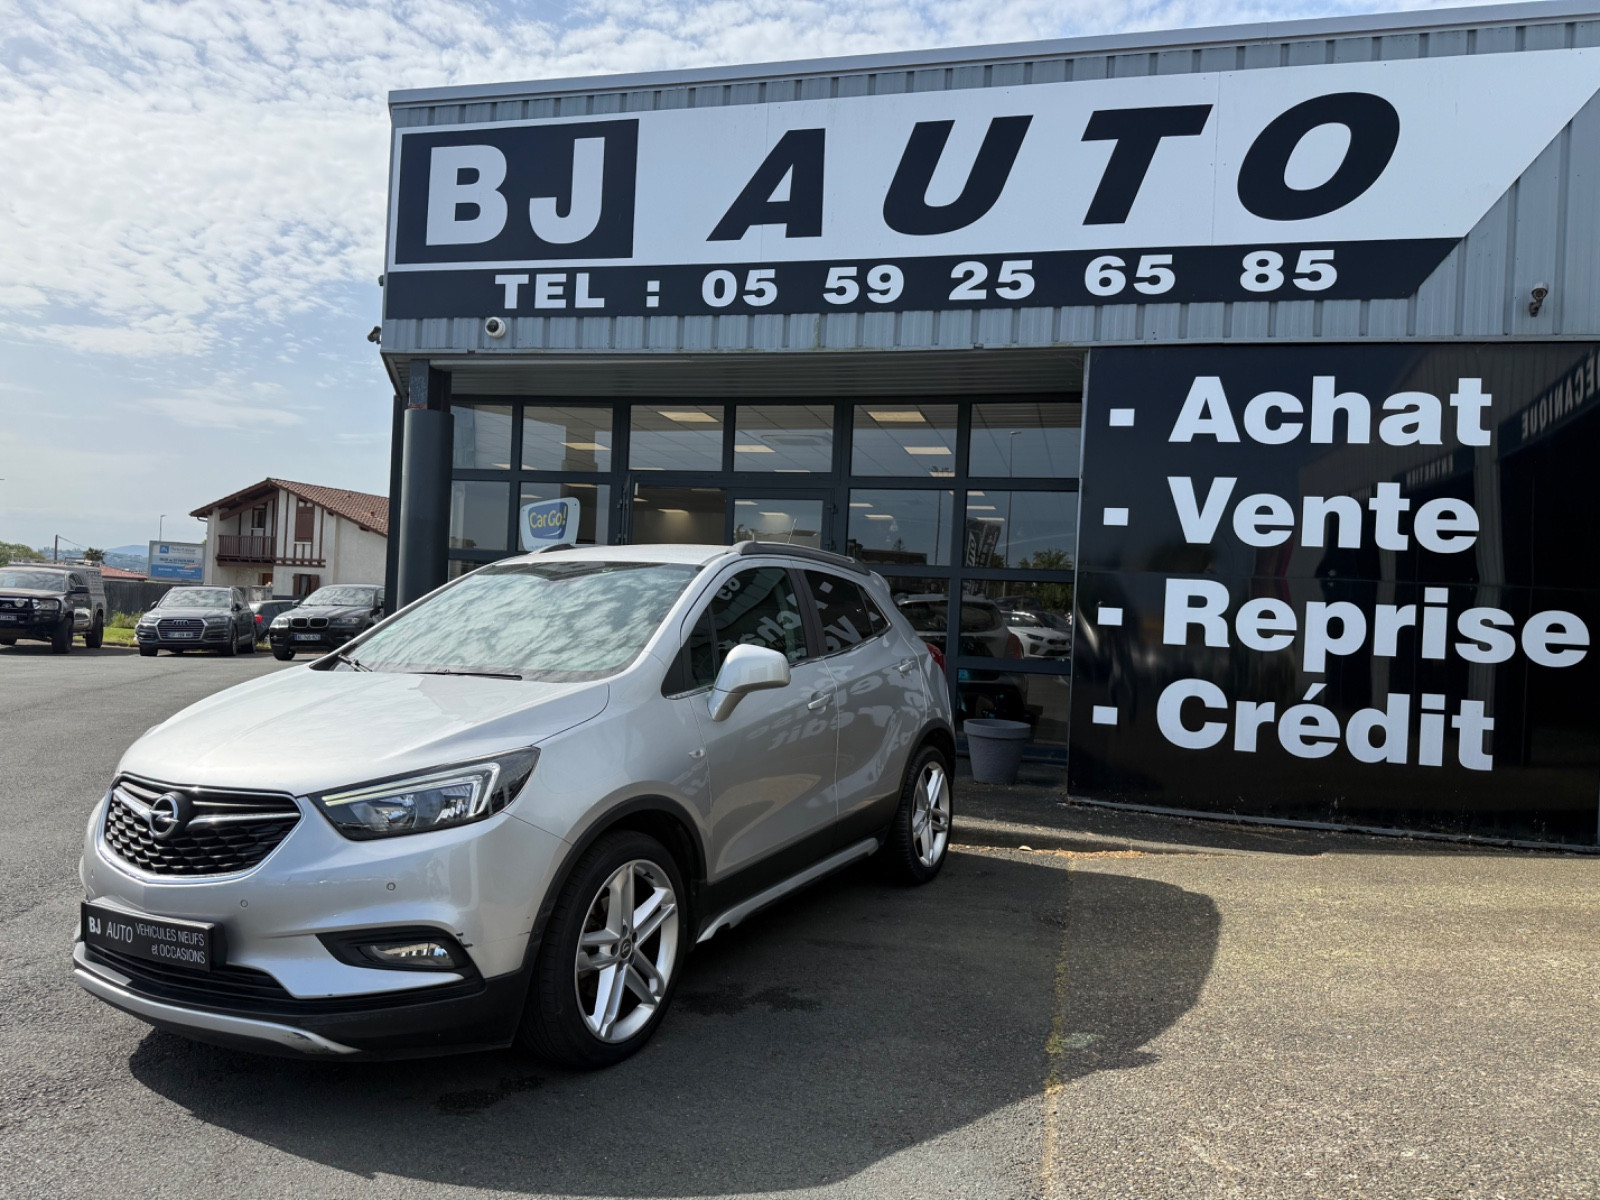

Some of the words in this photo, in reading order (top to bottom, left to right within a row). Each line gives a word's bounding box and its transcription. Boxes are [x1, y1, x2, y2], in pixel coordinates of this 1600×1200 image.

[426, 137, 605, 245] BJ
[706, 92, 1400, 241] AUTO
[495, 273, 604, 308] TEL
[702, 269, 777, 307] 05
[824, 265, 904, 304] 59
[949, 260, 1034, 300] 25
[1085, 254, 1175, 296] 65
[1240, 249, 1337, 291] 85
[1169, 376, 1491, 446] Achat
[1168, 477, 1479, 553] Vente
[1163, 579, 1589, 672] Reprise
[1157, 679, 1494, 770] Crédit
[88, 916, 101, 935] BJ
[106, 921, 133, 943] AUTO
[135, 922, 176, 943] VEHICULES
[178, 931, 205, 946] NEUFS
[151, 945, 158, 955] et
[160, 944, 206, 964] OCCASIONS
